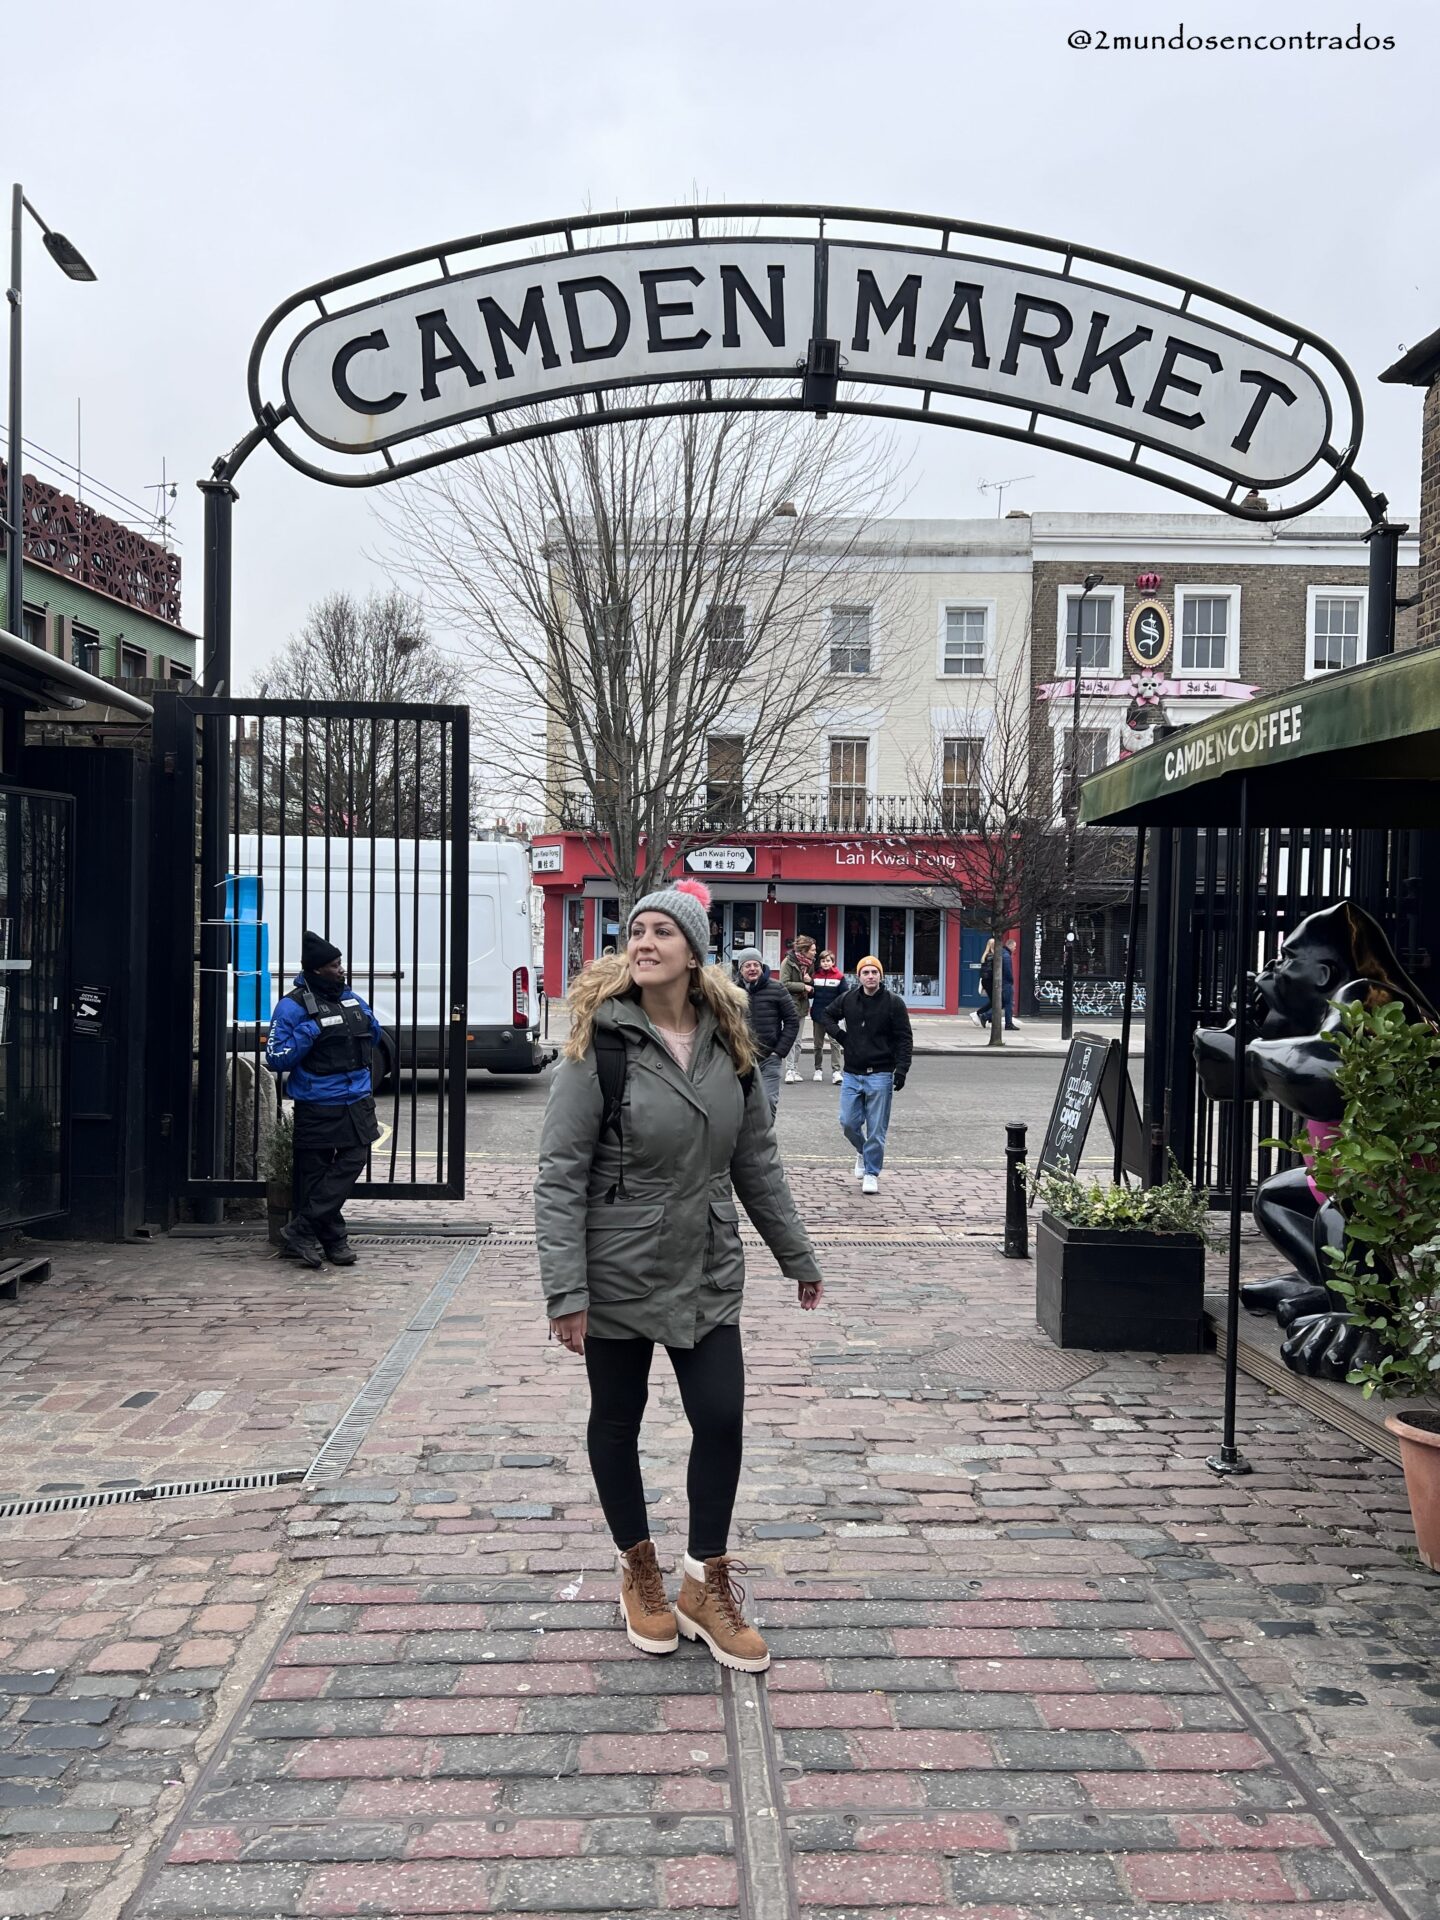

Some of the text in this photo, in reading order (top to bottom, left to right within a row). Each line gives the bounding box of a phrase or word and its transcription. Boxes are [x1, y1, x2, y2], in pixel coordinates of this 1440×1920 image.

[332, 265, 1298, 454] CAMDEN MARKET
[694, 849, 708, 857] Lan
[726, 850, 745, 859] Fong
[836, 849, 956, 869] Lan Kwai Fong
